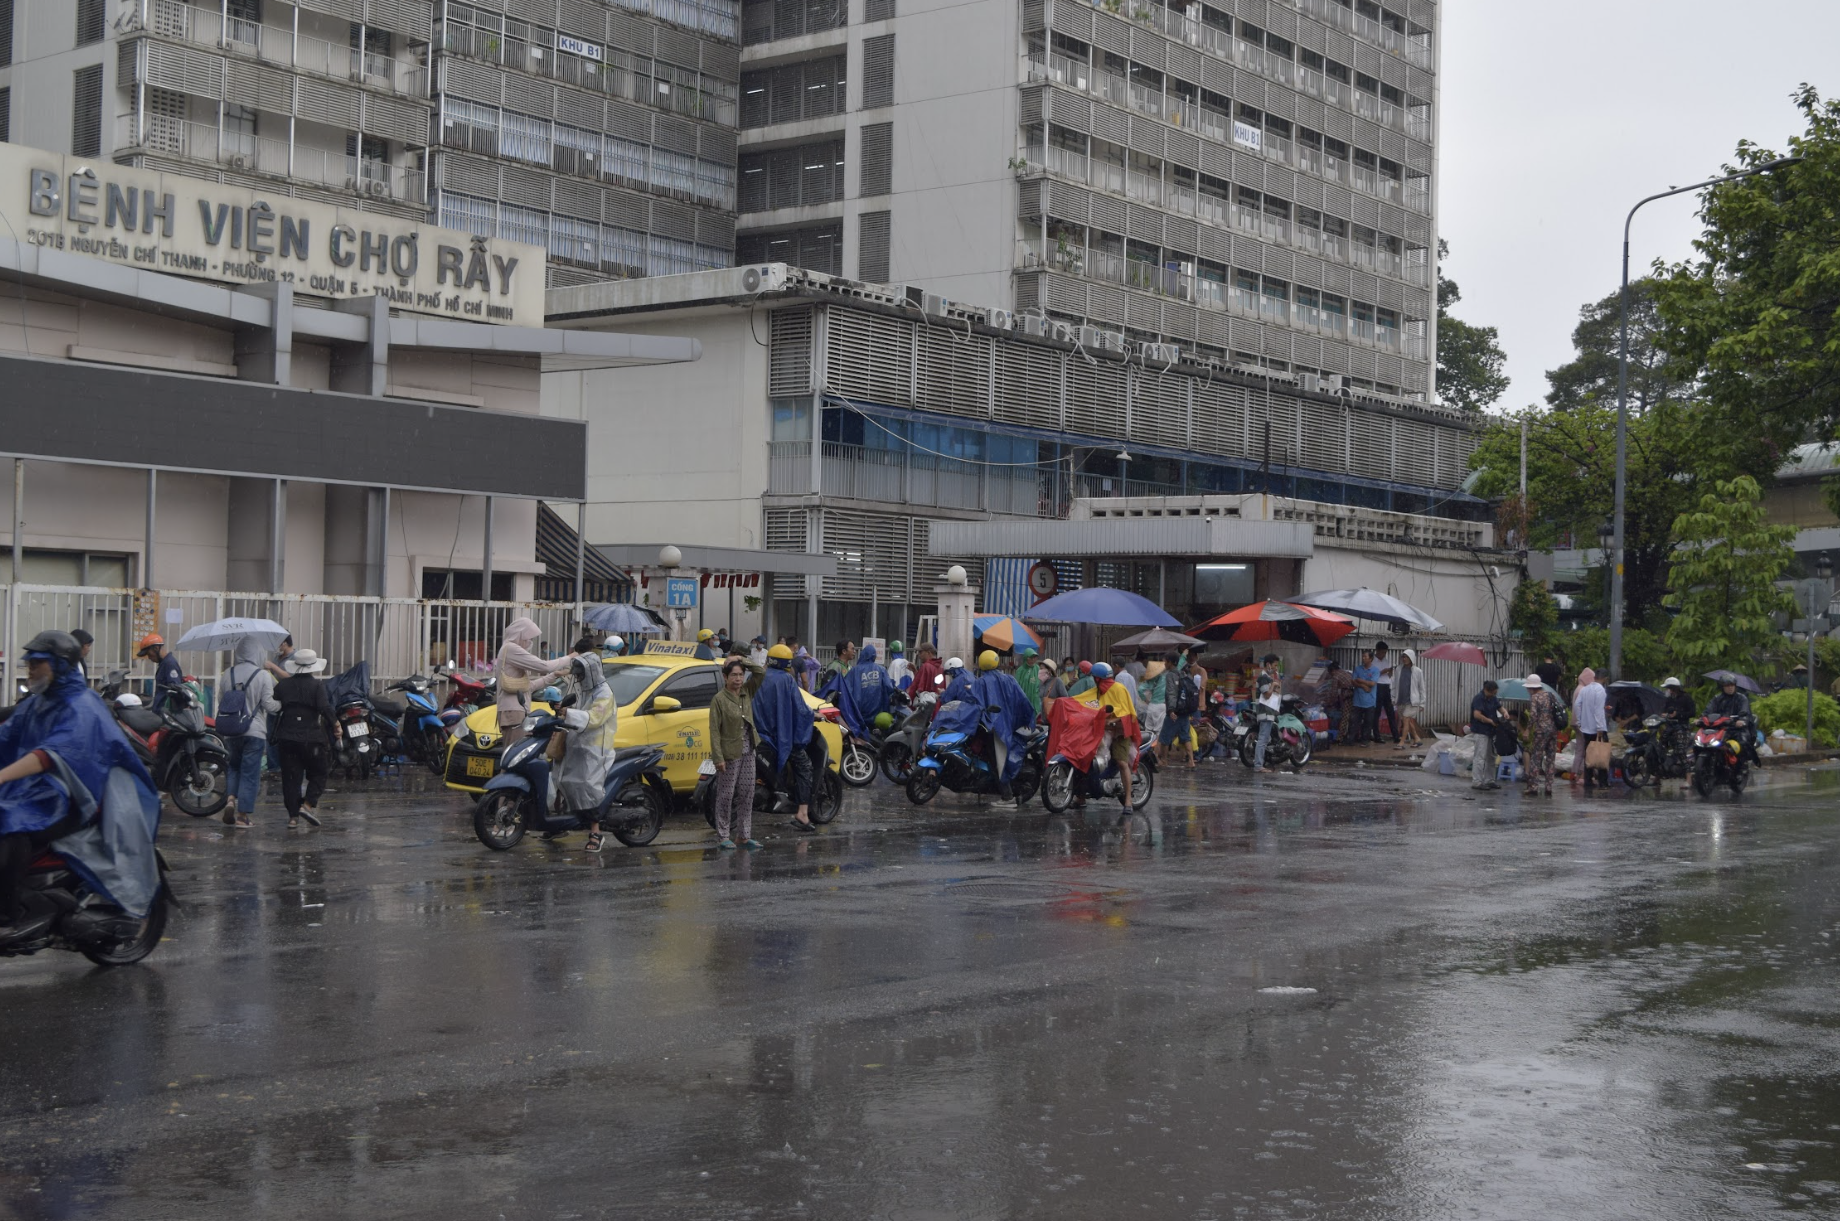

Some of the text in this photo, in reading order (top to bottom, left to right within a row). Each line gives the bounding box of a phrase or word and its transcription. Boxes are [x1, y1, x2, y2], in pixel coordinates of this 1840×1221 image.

[561, 37, 599, 57] KHU B1
[1234, 125, 1259, 146] KHU B1
[30, 166, 519, 295] BỆNH VIỆN CHỢ RẪY
[27, 229, 66, 249] 201B
[71, 237, 128, 260] NGUYỄN
[134, 245, 158, 264] CHÍ
[162, 250, 207, 272] THANH
[281, 271, 295, 284] 12
[310, 274, 345, 296] QUẬN
[350, 281, 358, 296] 5
[373, 285, 413, 305] THÀNH
[417, 291, 442, 310] PHỐ
[464, 300, 483, 316] CHÍ
[487, 304, 513, 321] MINH
[1040, 572, 1047, 588] 5
[673, 593, 691, 605] 1A
[647, 642, 695, 655] Vinataxi
[861, 670, 880, 681] ACB
